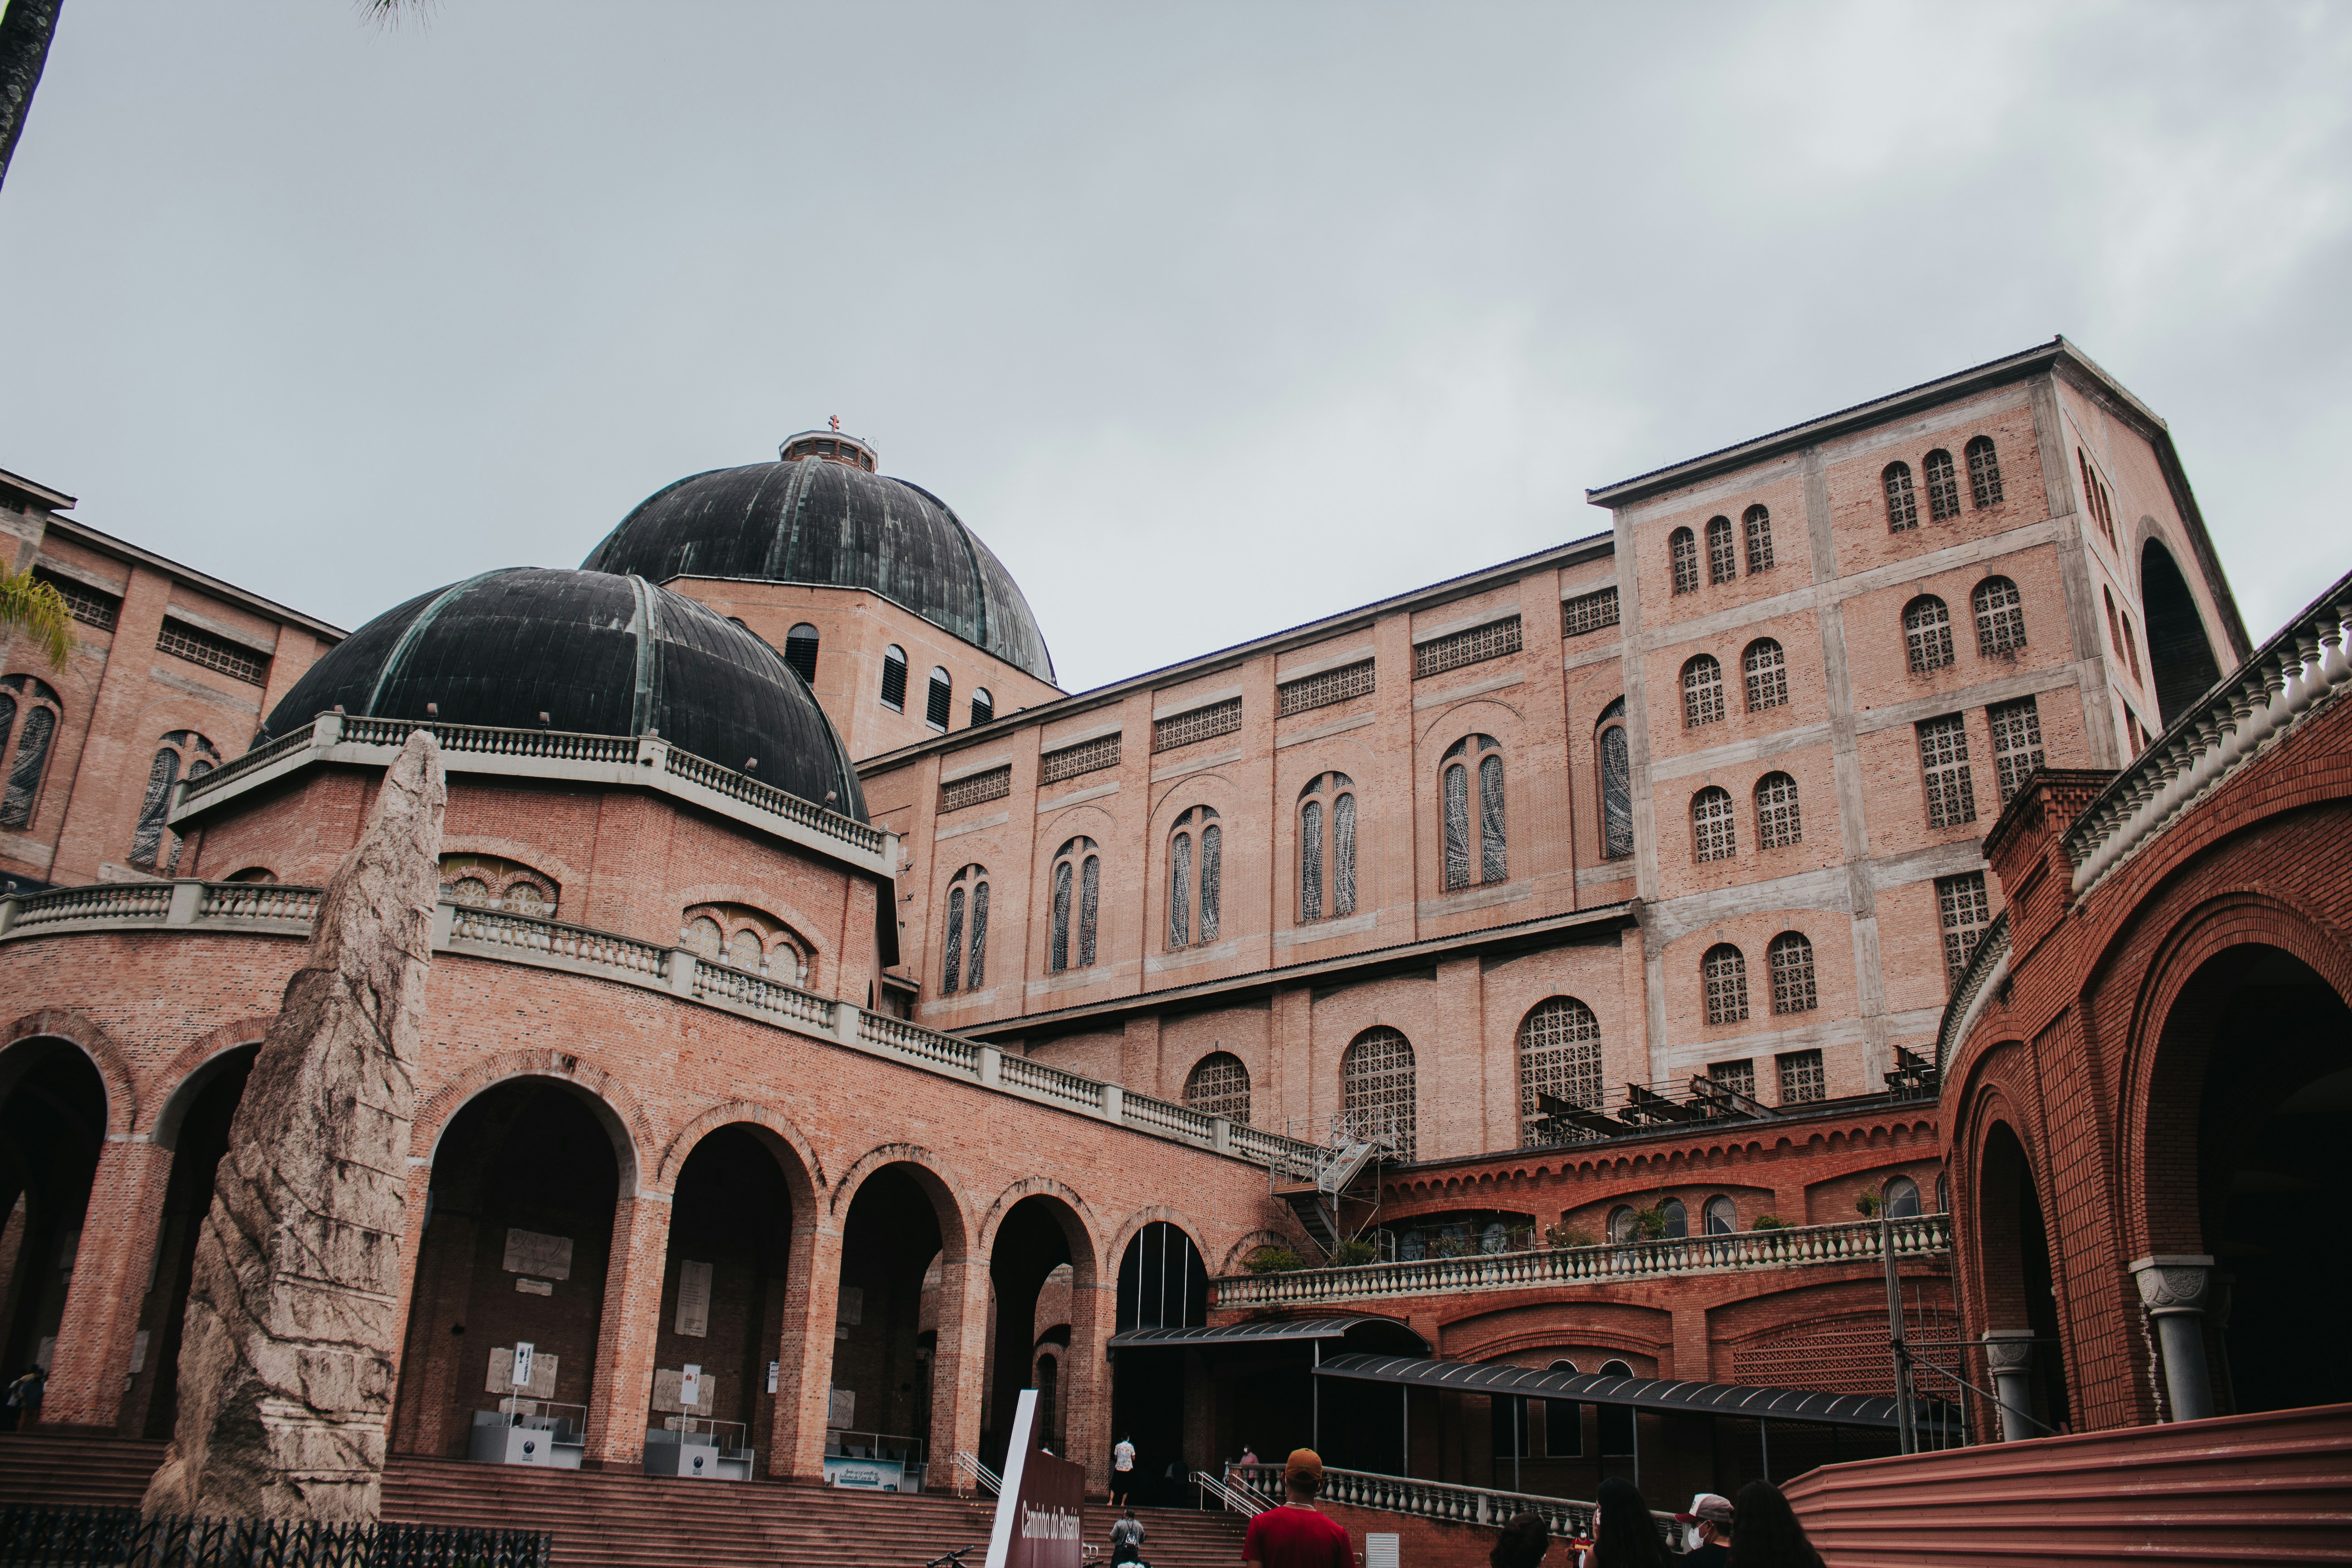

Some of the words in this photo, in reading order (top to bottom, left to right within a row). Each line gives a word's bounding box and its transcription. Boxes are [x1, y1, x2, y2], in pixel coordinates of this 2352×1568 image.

[1022, 1500, 1049, 1539] Caminho
[1051, 1505, 1058, 1540] do
[1059, 1506, 1079, 1540] Rosário
